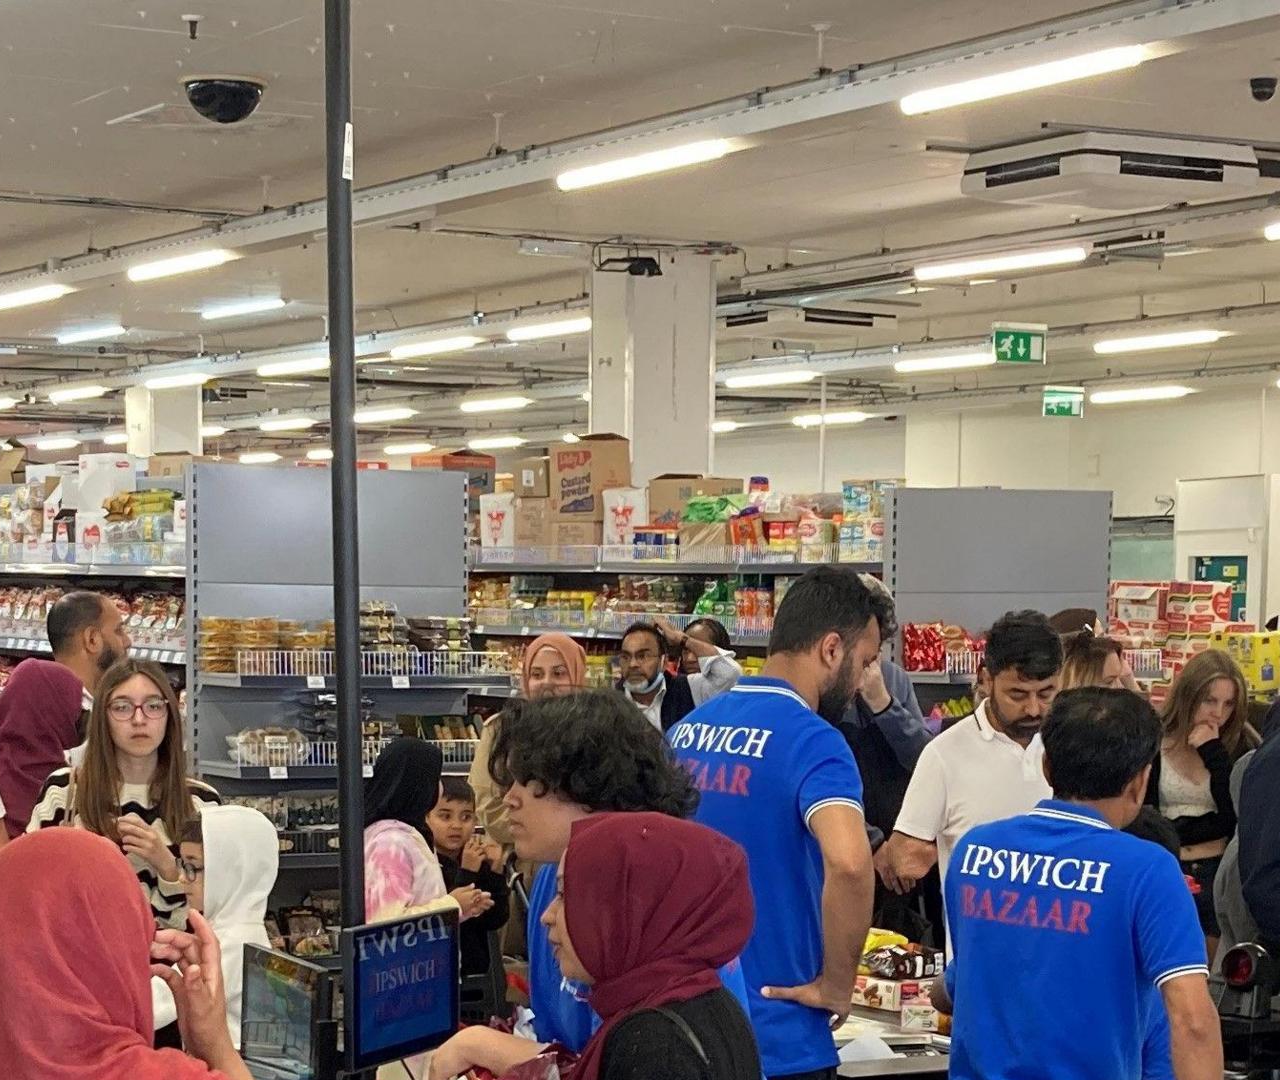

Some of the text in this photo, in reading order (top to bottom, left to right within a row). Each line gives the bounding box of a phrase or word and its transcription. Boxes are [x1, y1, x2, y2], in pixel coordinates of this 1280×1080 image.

[560, 472, 592, 489] Custard
[560, 485, 590, 501] powder
[672, 722, 773, 759] IPSWICH
[678, 757, 753, 797] ZAAR
[960, 843, 1111, 894] IPSWICH
[960, 883, 1092, 935] BAZAAR
[375, 959, 435, 993] IPSWICH
